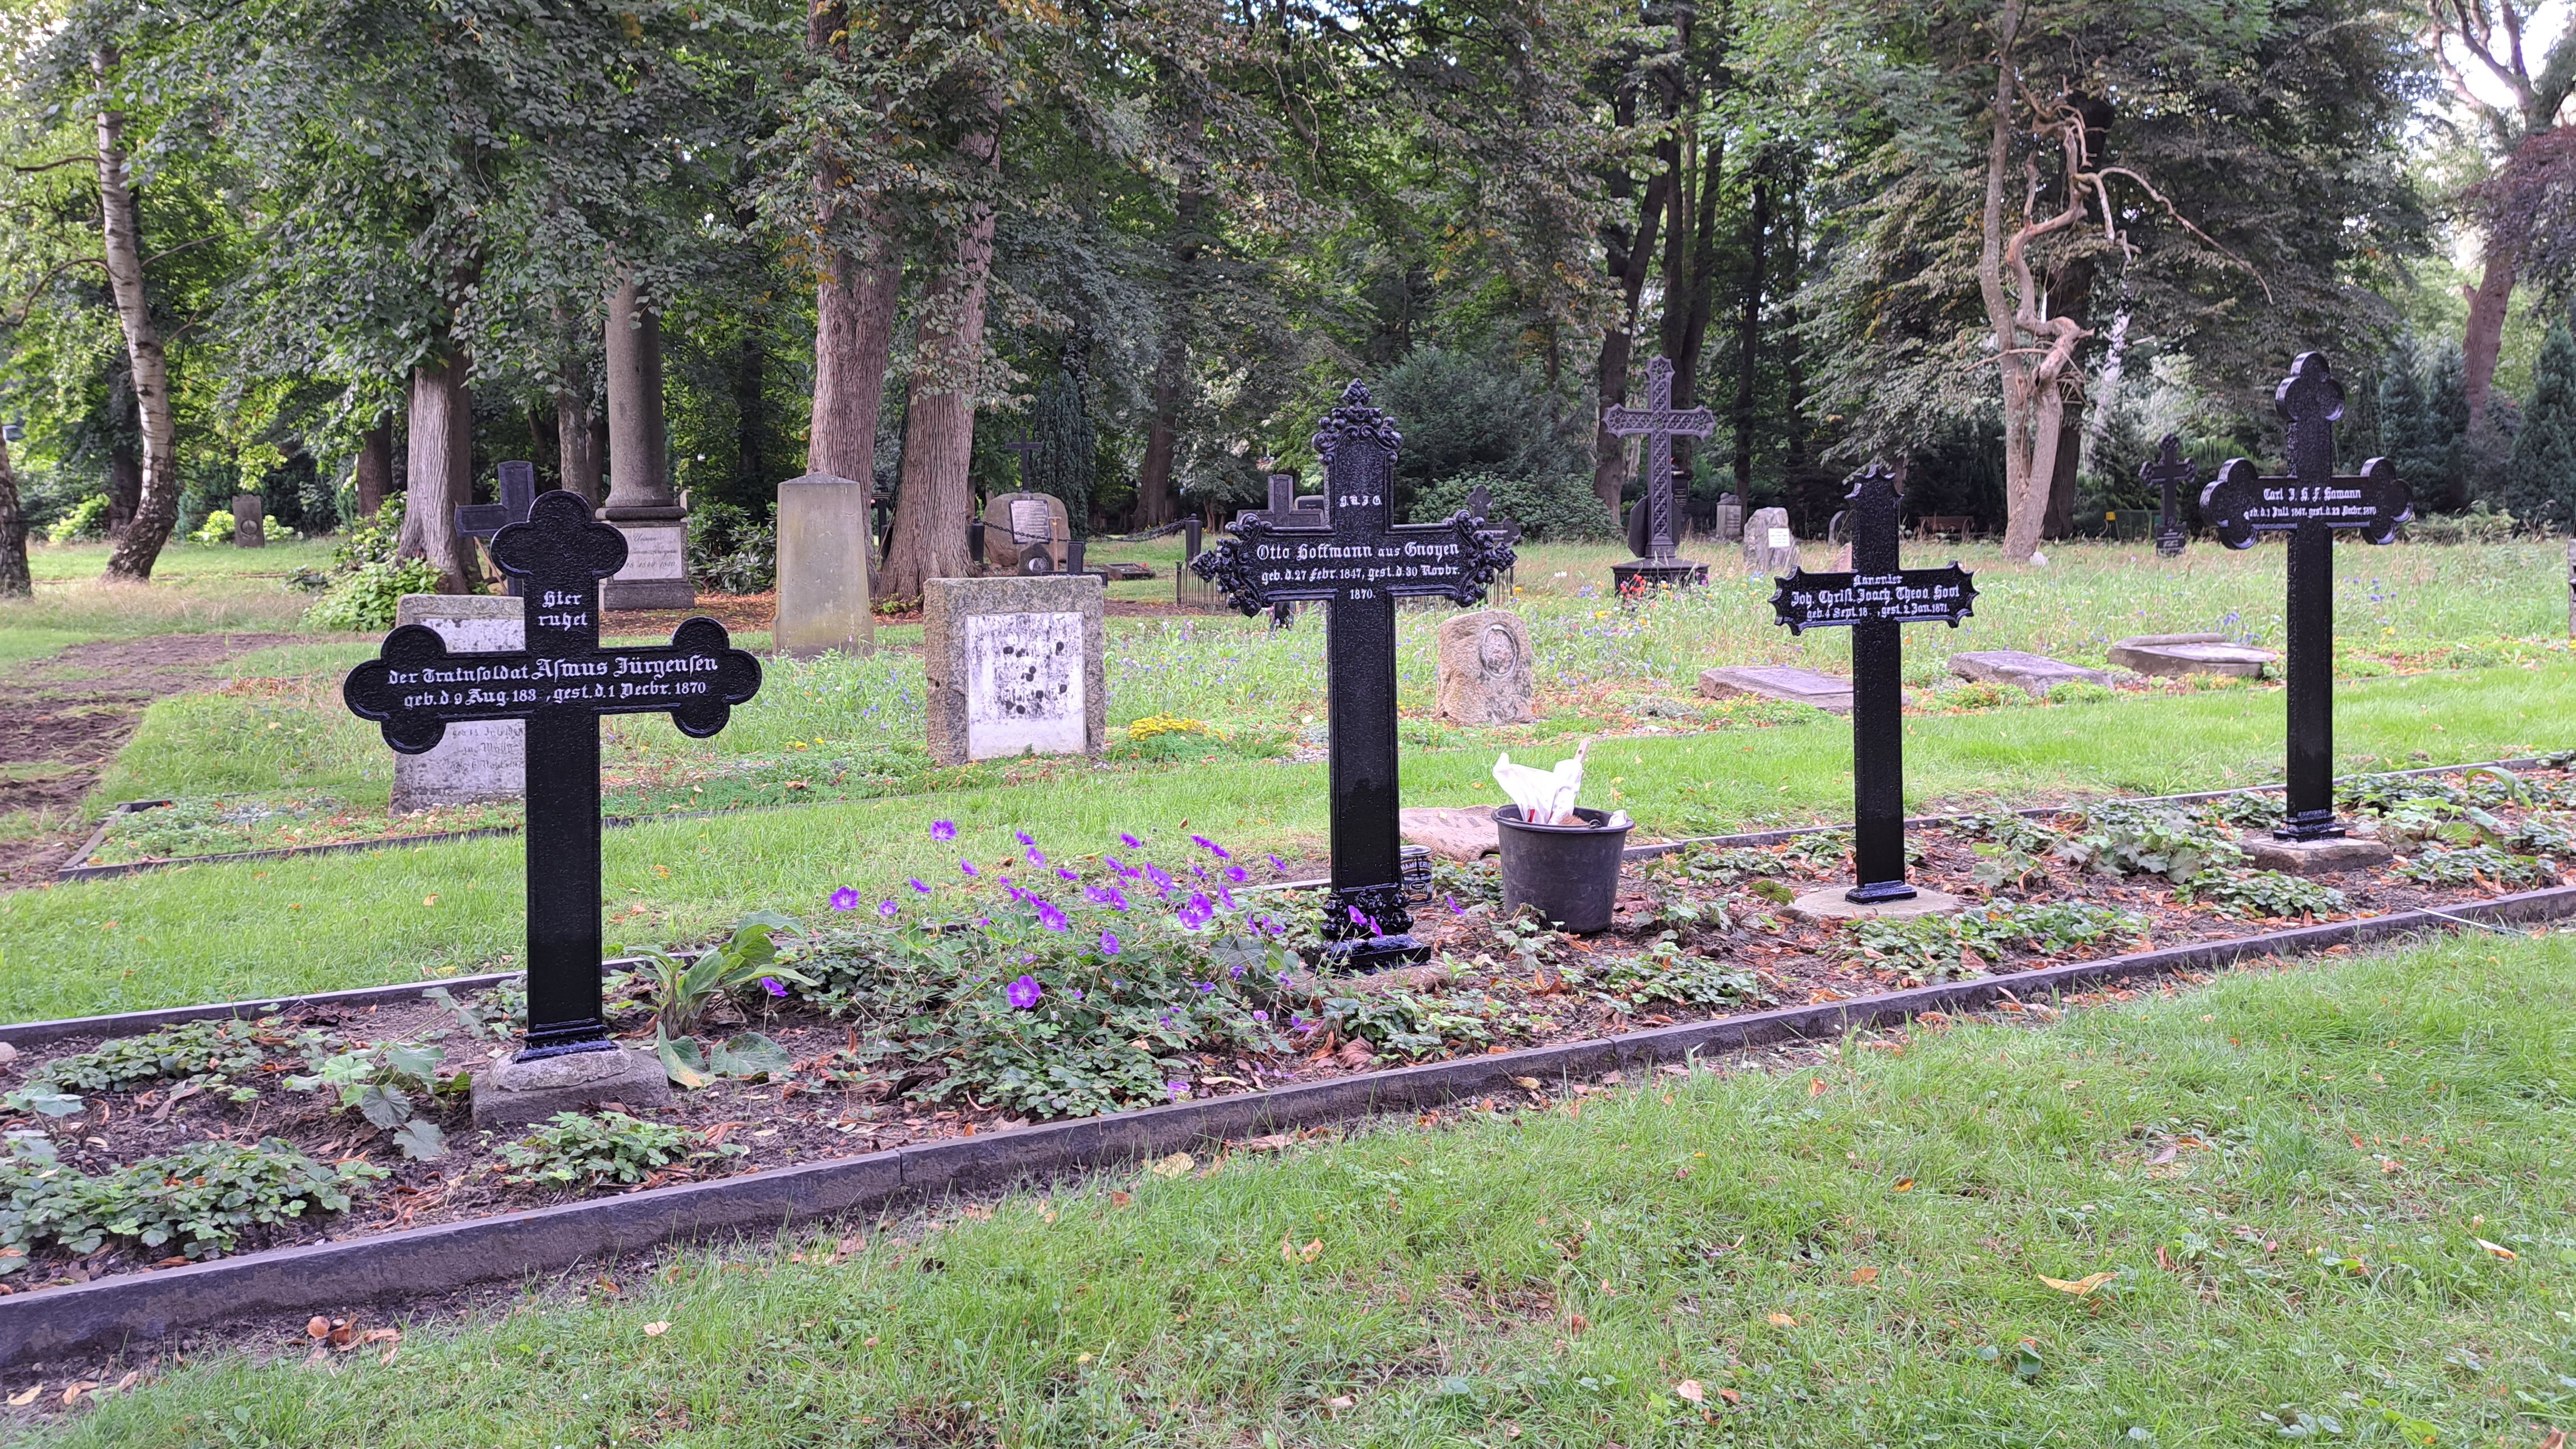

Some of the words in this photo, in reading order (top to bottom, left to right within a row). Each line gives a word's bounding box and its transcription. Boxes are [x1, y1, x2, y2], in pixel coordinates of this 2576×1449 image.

[2263, 487, 2284, 501] Carl
[1256, 544, 1290, 560] Otto
[1296, 542, 1373, 561] Hoffmann
[1378, 548, 1401, 557] aus
[1404, 541, 1460, 563] Gnoyen
[1261, 569, 1283, 586] geb.
[1294, 569, 1307, 580] 27
[1367, 565, 1394, 582] gest.
[1406, 566, 1418, 577] 30
[541, 591, 582, 608] Hier
[1790, 591, 1815, 609] Joh.
[538, 612, 588, 631] ruhet
[1824, 607, 1831, 618] 4
[388, 670, 419, 685] der
[404, 691, 437, 708] geb.
[454, 692, 462, 705] 9
[465, 689, 509, 707] Aug.
[553, 685, 593, 704] gest.
[608, 685, 615, 697] 1
[620, 680, 671, 699] Decbr.
[675, 682, 706, 694] 1870
